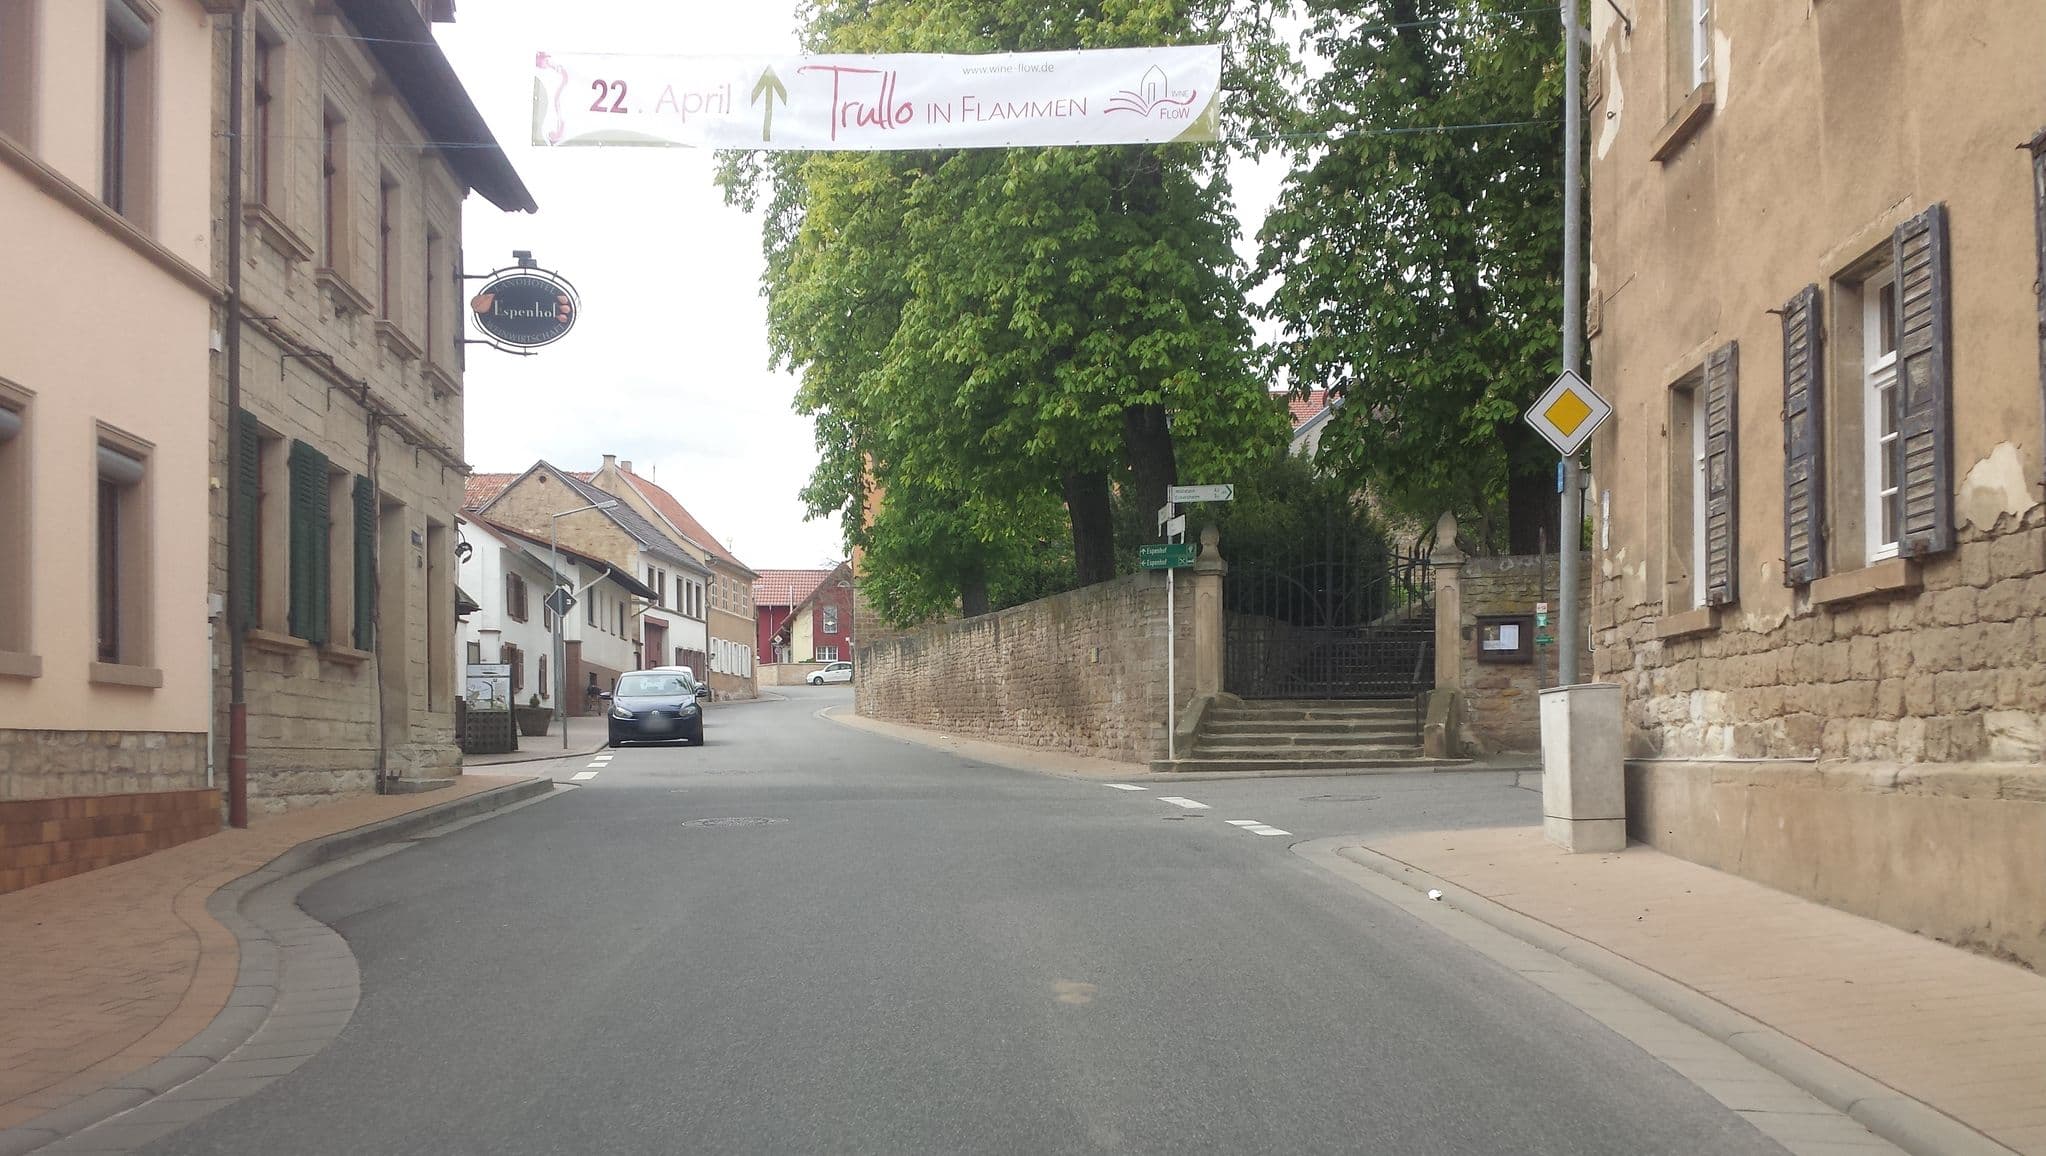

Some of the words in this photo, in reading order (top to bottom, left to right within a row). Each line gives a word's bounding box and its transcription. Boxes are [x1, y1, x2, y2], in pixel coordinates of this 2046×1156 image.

[961, 62, 1055, 75] www.wine-flow.de
[655, 83, 732, 124] April
[797, 65, 914, 141] Trullo
[927, 102, 951, 125] IN
[962, 95, 1088, 122] FLAMMEN
[494, 278, 557, 295] LANDHOTEL
[494, 299, 558, 319] Espenhof
[1146, 547, 1167, 555] Espenhof
[1146, 558, 1168, 567] Espenhof
